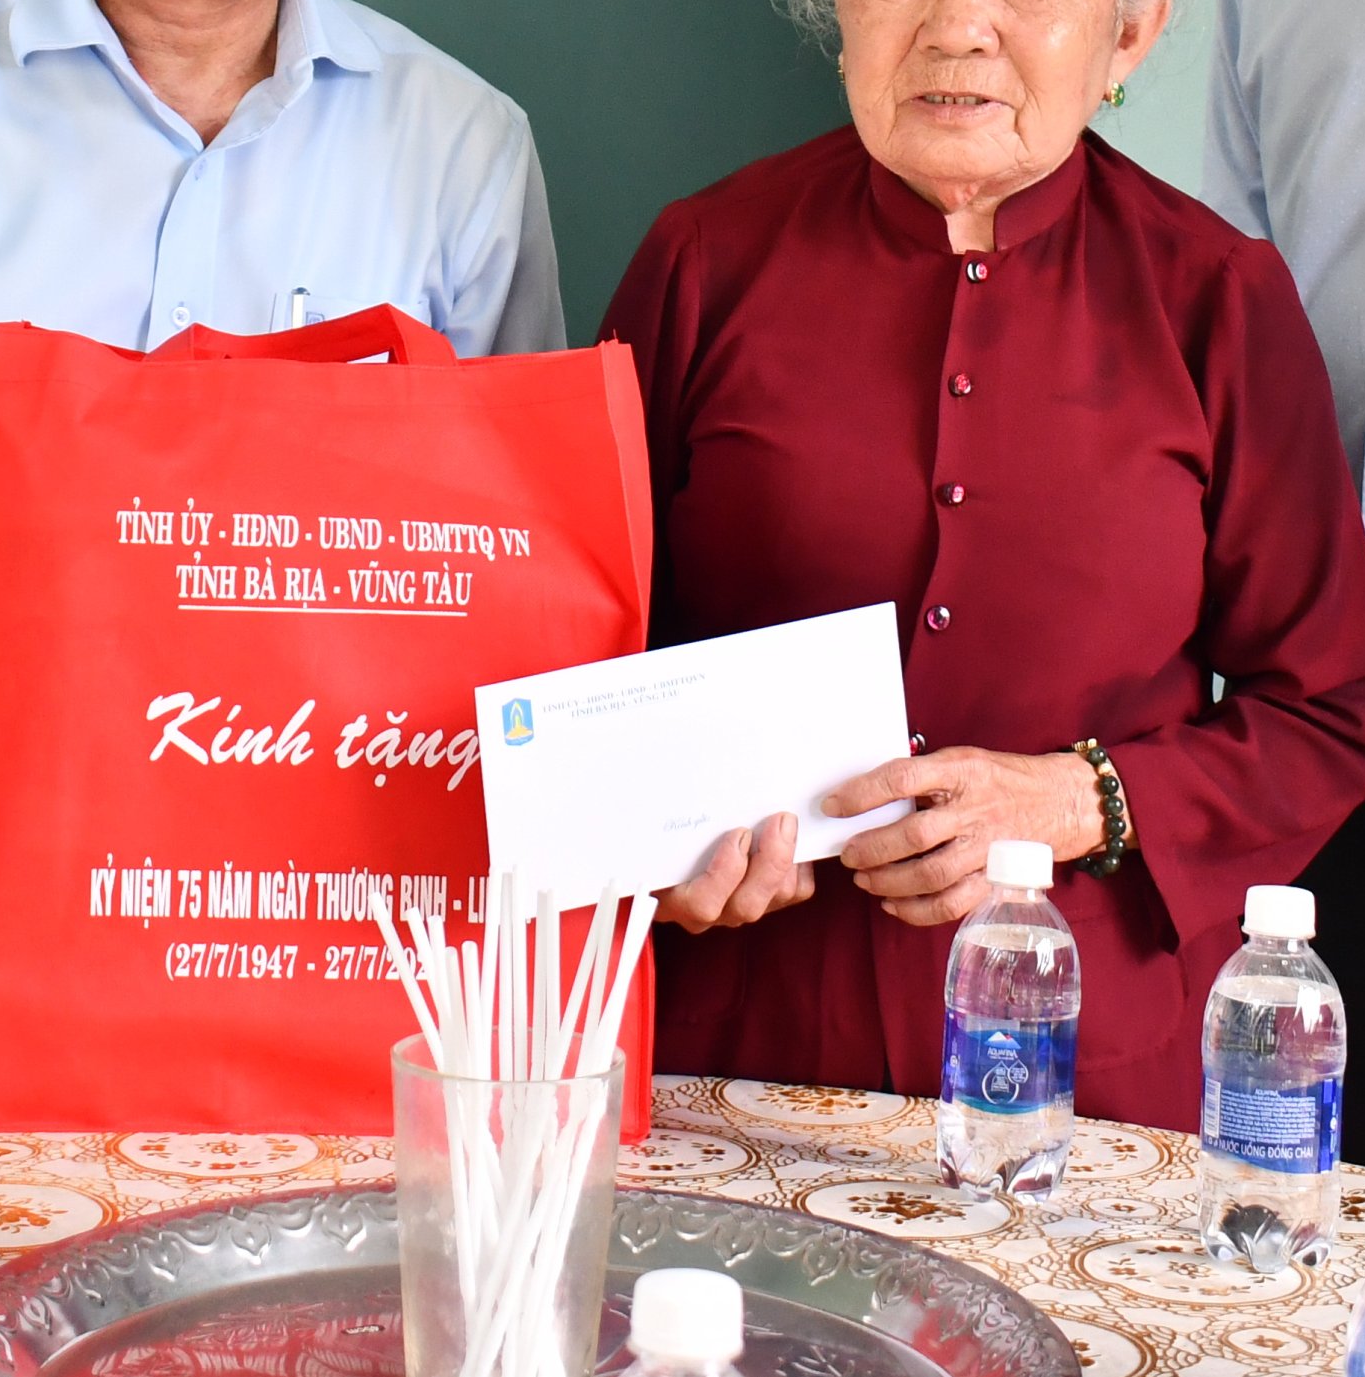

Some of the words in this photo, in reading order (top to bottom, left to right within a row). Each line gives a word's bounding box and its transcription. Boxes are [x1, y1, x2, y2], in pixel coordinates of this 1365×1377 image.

[116, 497, 173, 544] TỈNH
[180, 498, 214, 545] ỦY
[231, 513, 299, 548] HĐND
[318, 516, 382, 550] UBND
[400, 520, 496, 561] UBMTTQ
[498, 527, 531, 557] VN
[176, 551, 237, 600] TỈNH
[243, 557, 277, 601] BÀ
[283, 567, 326, 609] RỊA
[348, 561, 416, 604] VŨNG
[423, 562, 473, 605] TÀU
[146, 691, 315, 766] Kính
[334, 710, 481, 792] tặng
[90, 853, 116, 917] KỶ
[121, 856, 172, 929] NIỆM
[177, 870, 202, 919] 75
[207, 861, 252, 919] NĂM
[257, 860, 311, 920] NGÀY
[315, 866, 394, 923] THƯƠNG
[400, 874, 447, 923] BINH
[165, 942, 299, 981] (27/7/1947
[1241, 1142, 1266, 1157] UỐNG
[1295, 1147, 1313, 1158] CHAI
